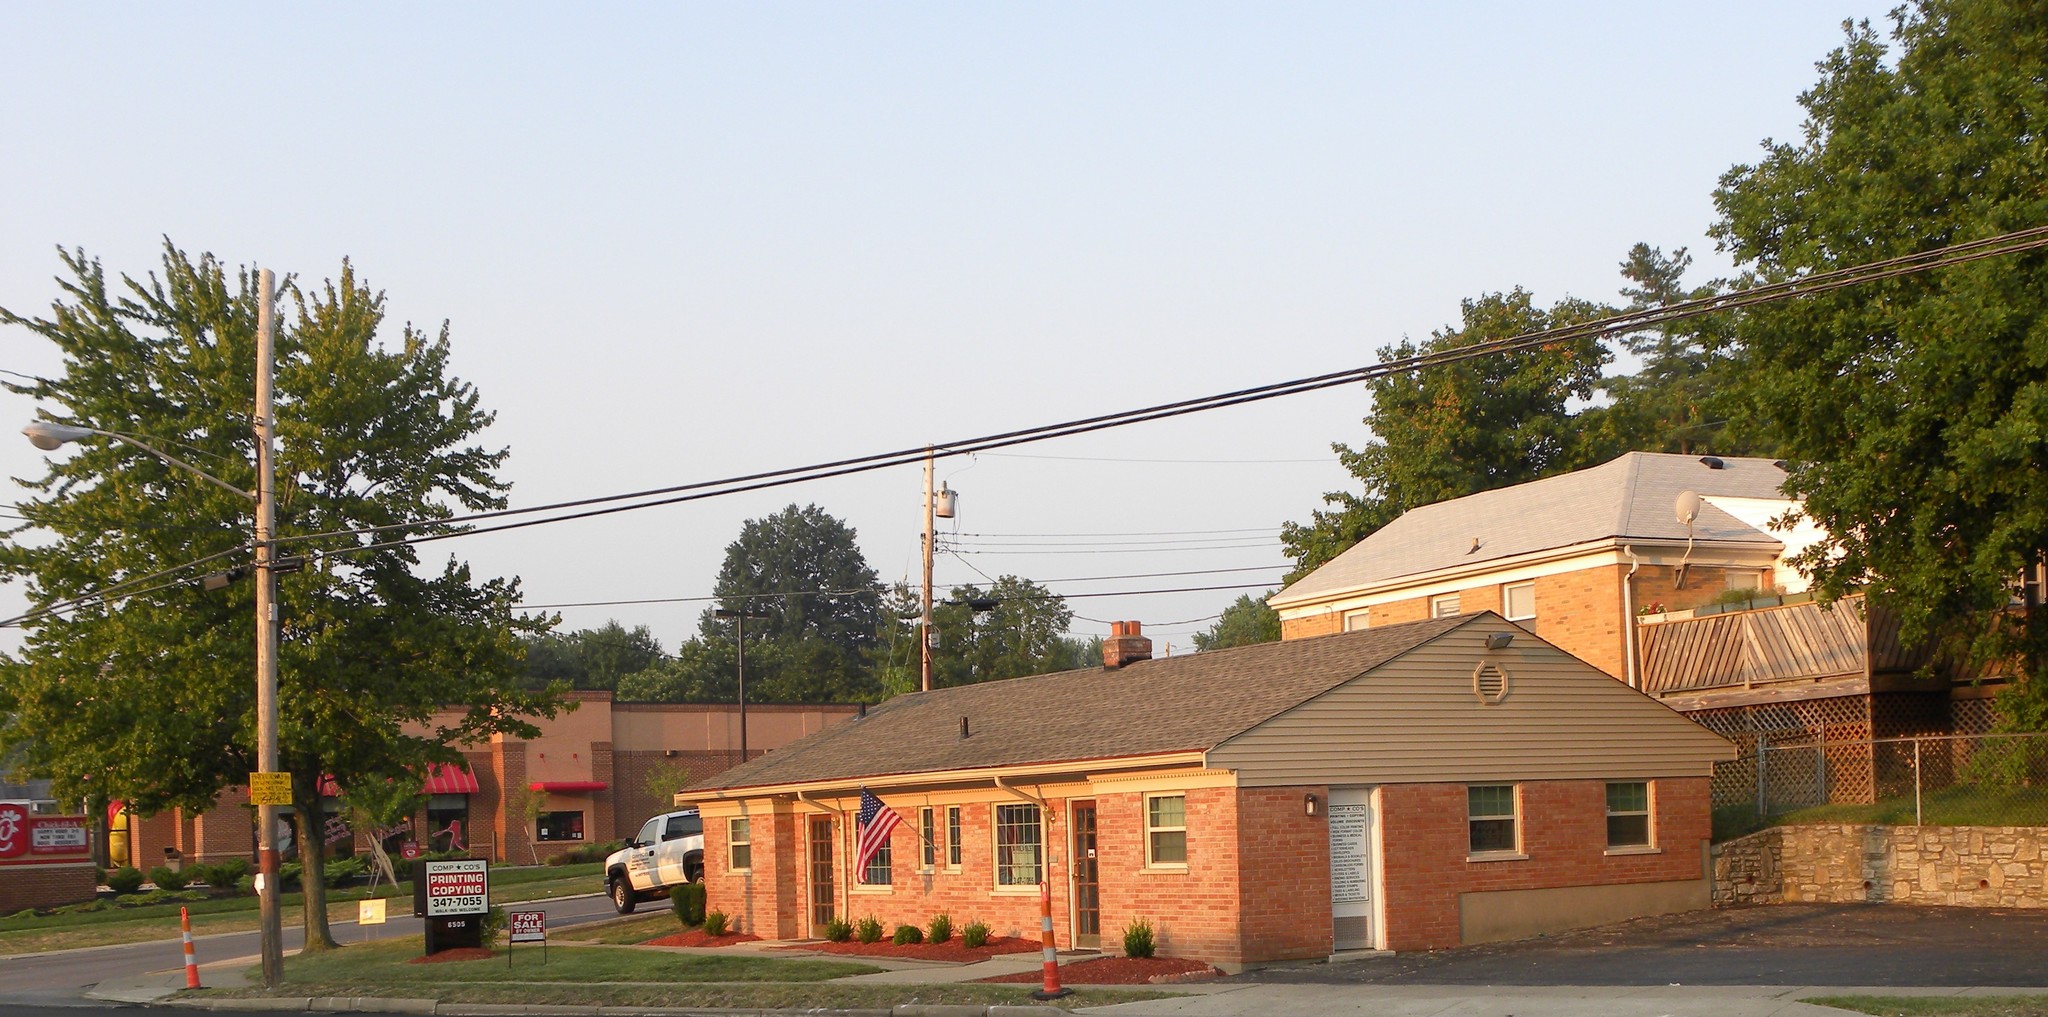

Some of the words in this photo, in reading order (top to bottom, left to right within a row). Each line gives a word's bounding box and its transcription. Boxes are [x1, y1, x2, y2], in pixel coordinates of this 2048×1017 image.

[430, 874, 483, 884] PRINTING
[432, 885, 482, 895] COPYING
[433, 897, 482, 907] 347-7055
